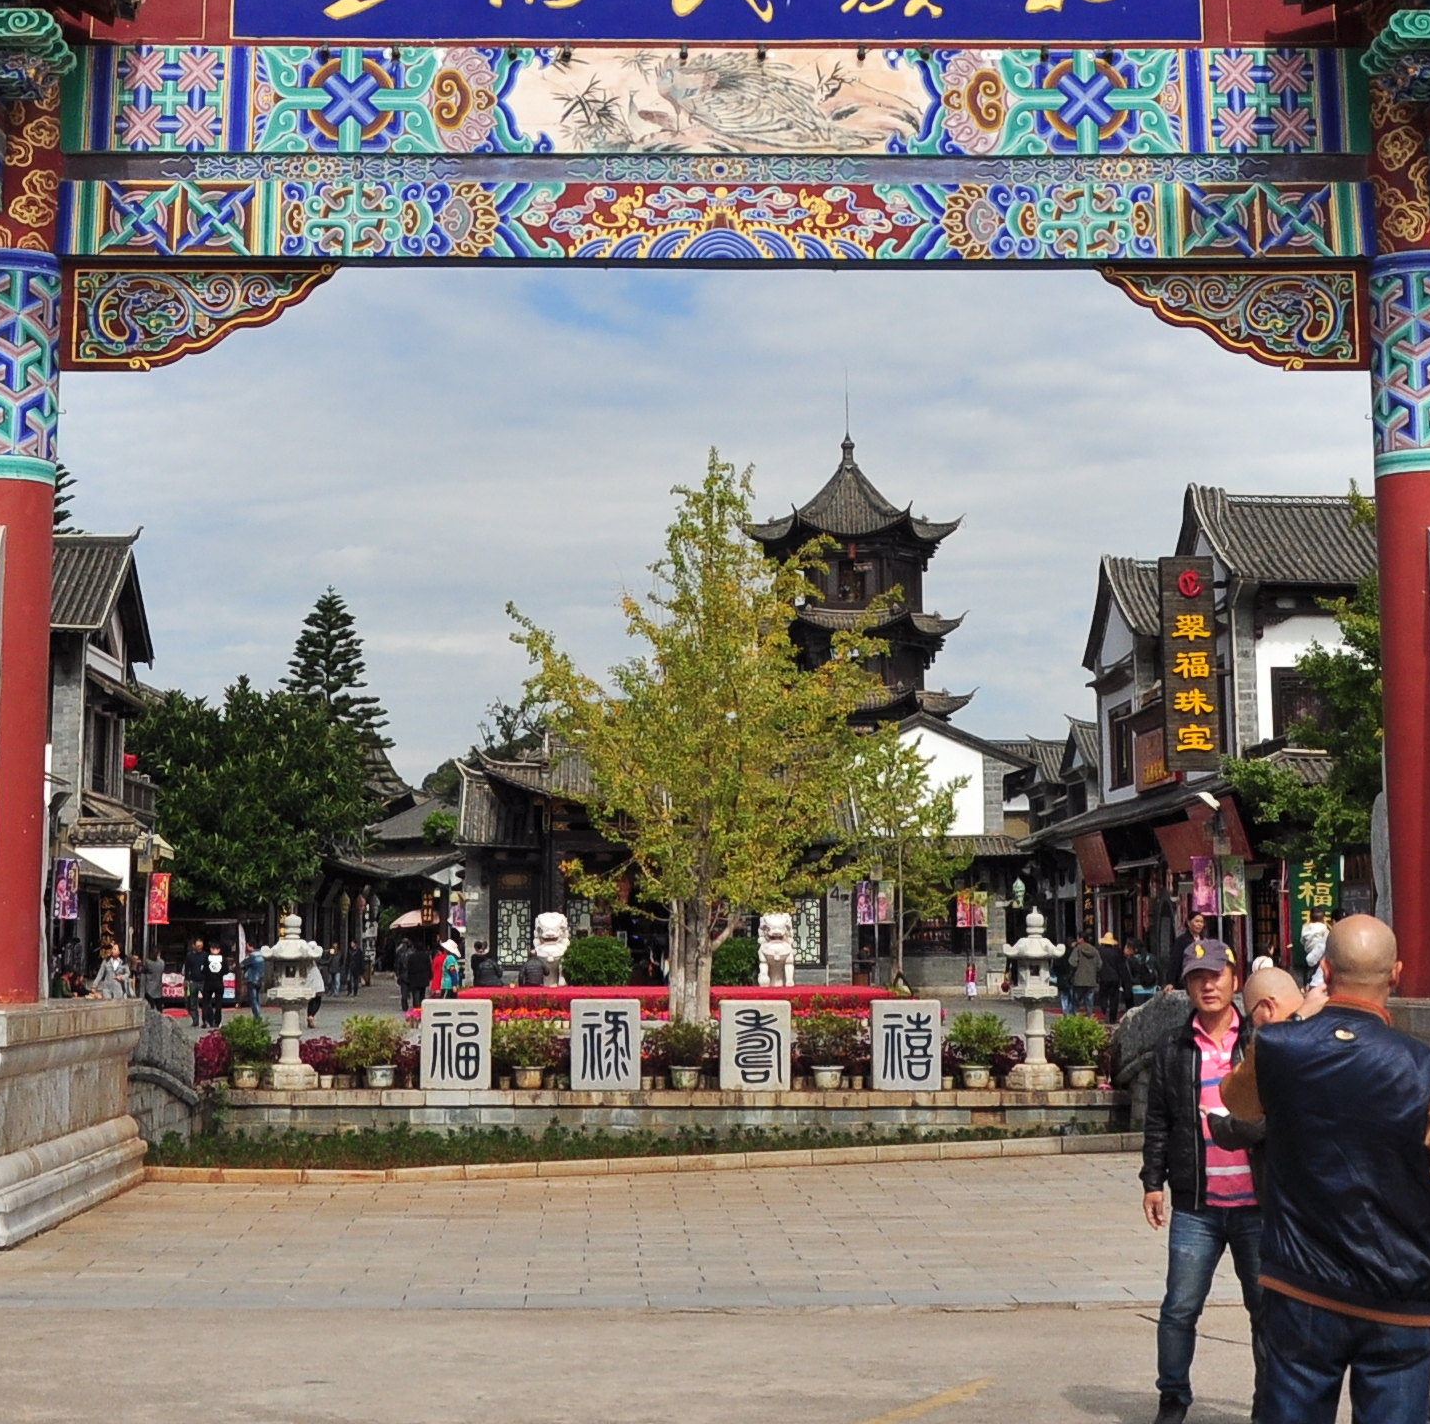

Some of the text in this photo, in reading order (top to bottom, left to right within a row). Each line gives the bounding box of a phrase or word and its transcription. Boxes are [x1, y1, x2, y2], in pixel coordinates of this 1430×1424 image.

[1171, 613, 1215, 752] 翠福珠宝
[430, 1011, 480, 1081] 福
[882, 1012, 934, 1081] 禧
